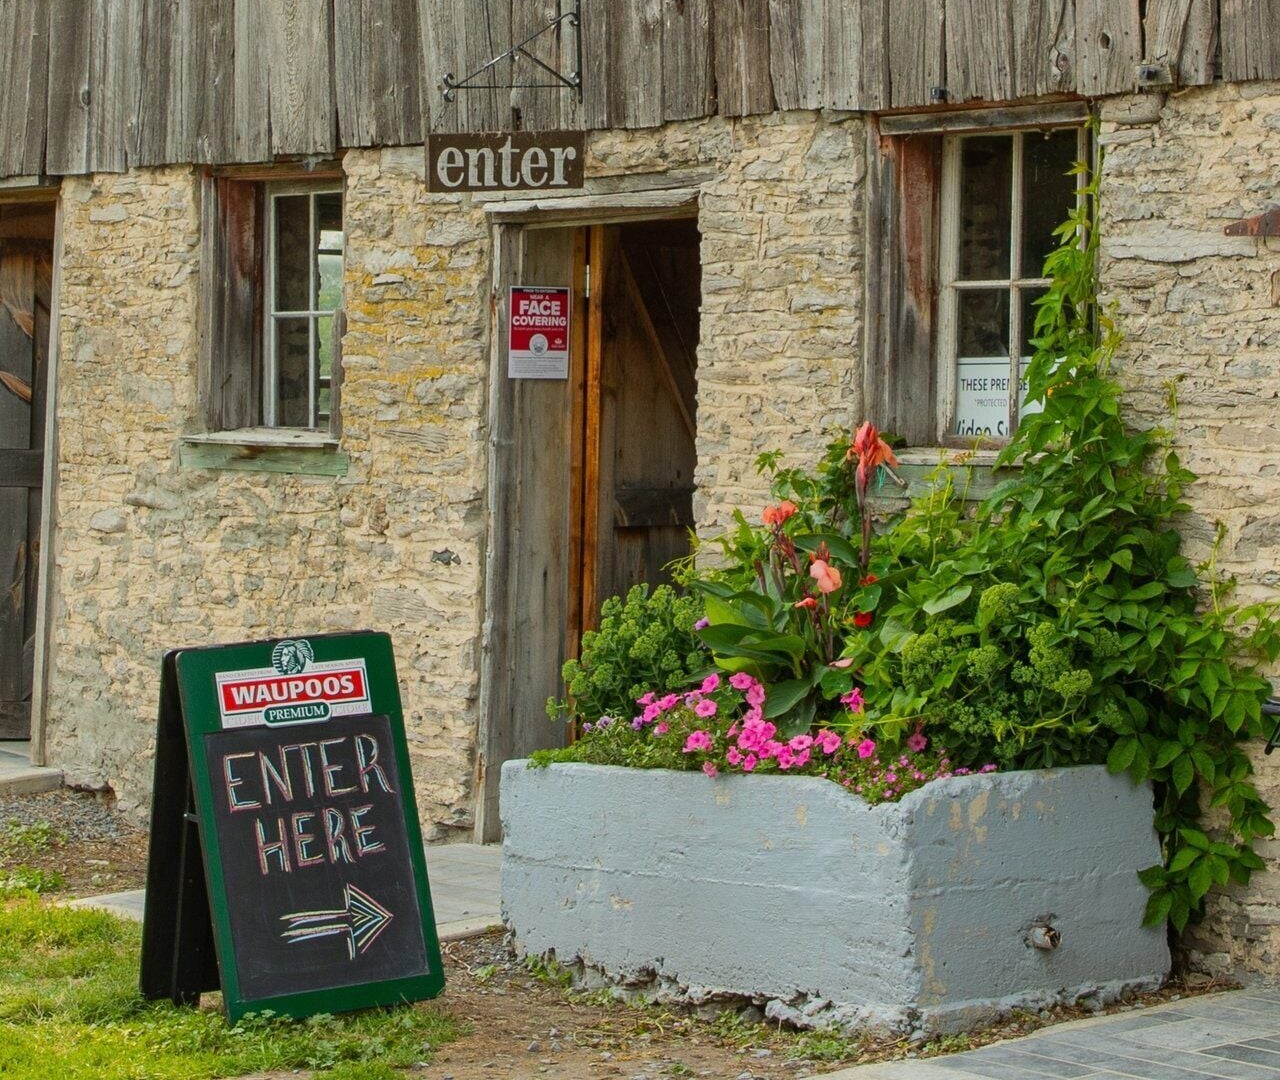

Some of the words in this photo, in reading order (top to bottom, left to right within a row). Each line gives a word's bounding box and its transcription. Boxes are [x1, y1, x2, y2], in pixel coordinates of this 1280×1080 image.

[437, 136, 576, 188] enter
[519, 300, 561, 315] FACE
[512, 316, 567, 326] COVERING
[961, 378, 987, 391] THESE
[269, 705, 325, 721] PREMIUM
[223, 734, 397, 813] ENTER
[256, 804, 387, 876] HERE
